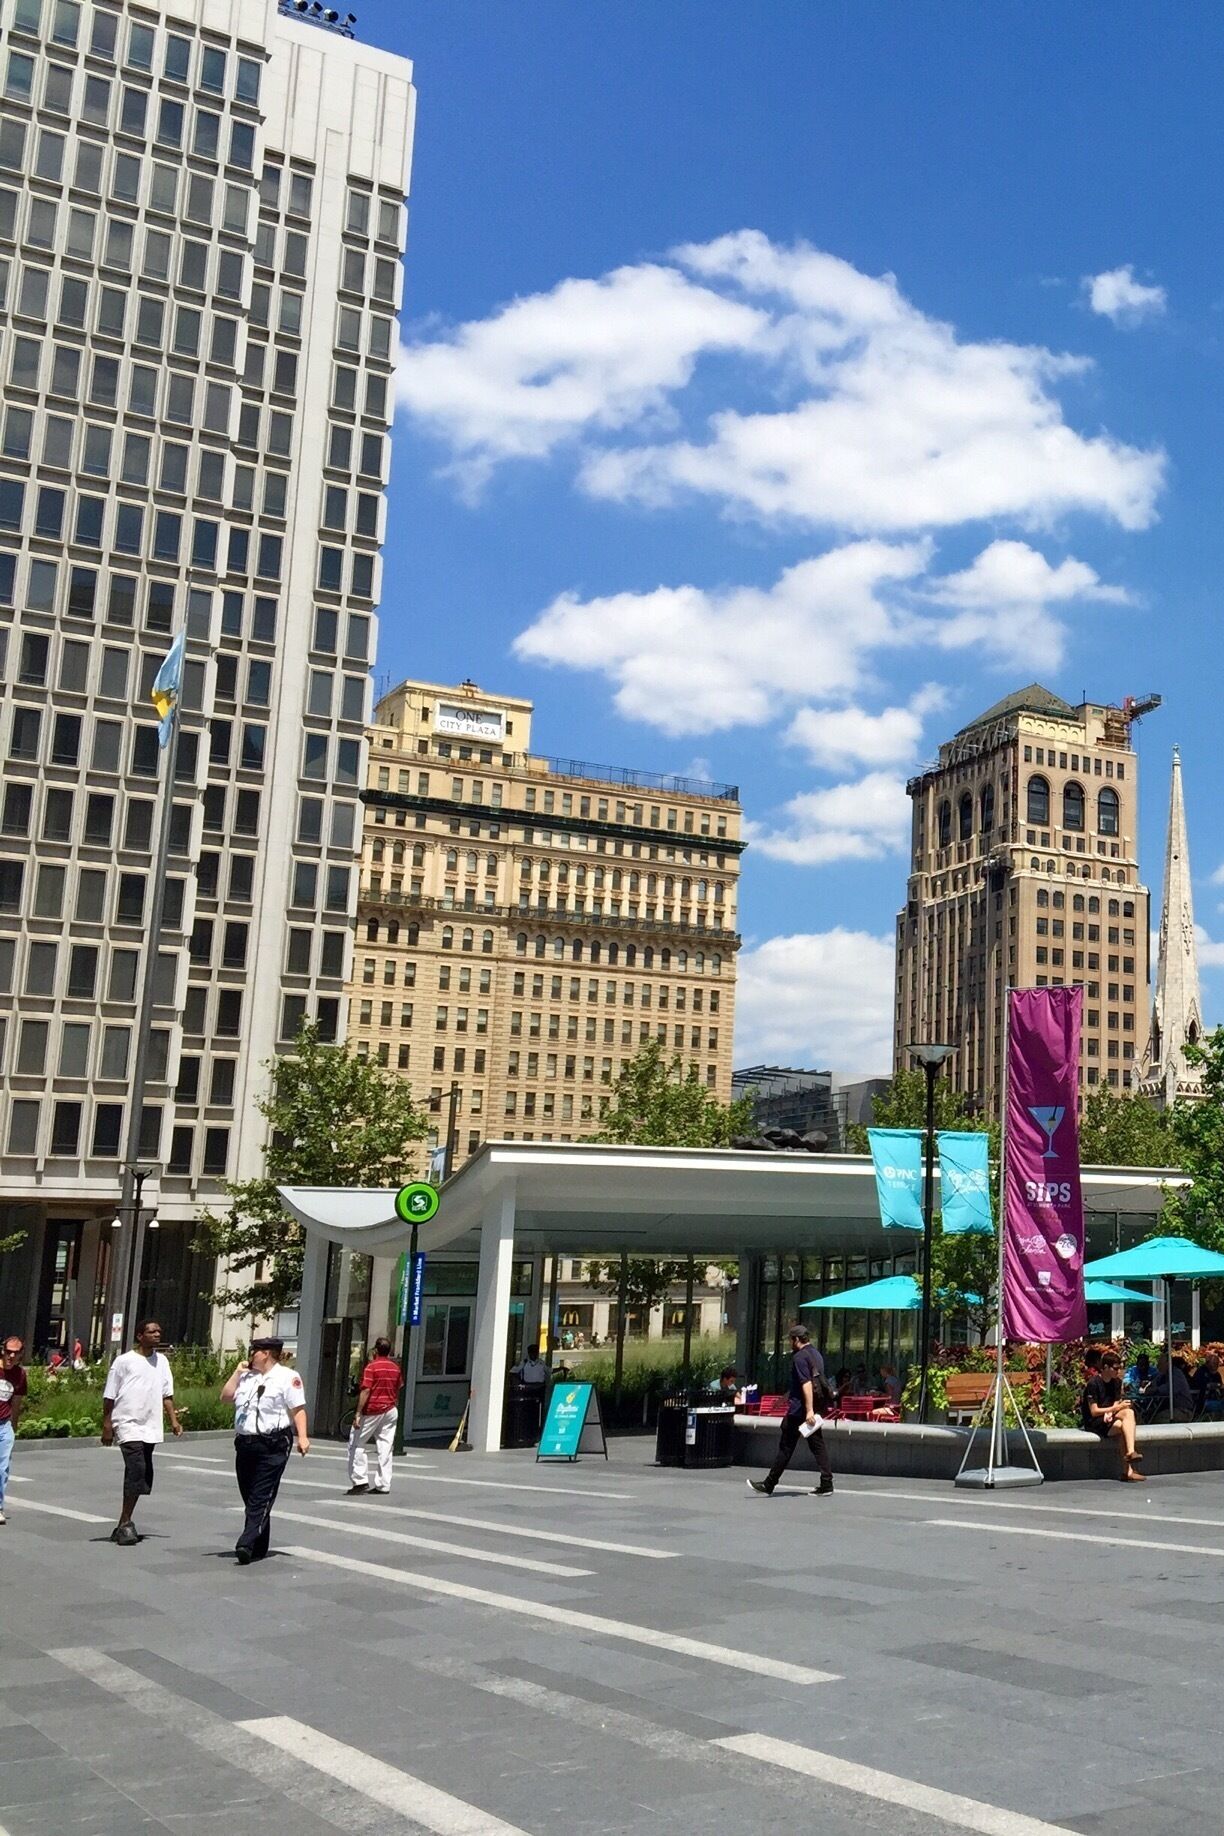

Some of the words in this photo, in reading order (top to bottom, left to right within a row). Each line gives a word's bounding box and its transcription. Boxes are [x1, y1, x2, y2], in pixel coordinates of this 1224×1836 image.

[455, 711, 482, 724] ONE
[440, 720, 462, 730] CITY
[466, 724, 497, 736] PLAZA
[1025, 1181, 1071, 1202] SIPS
